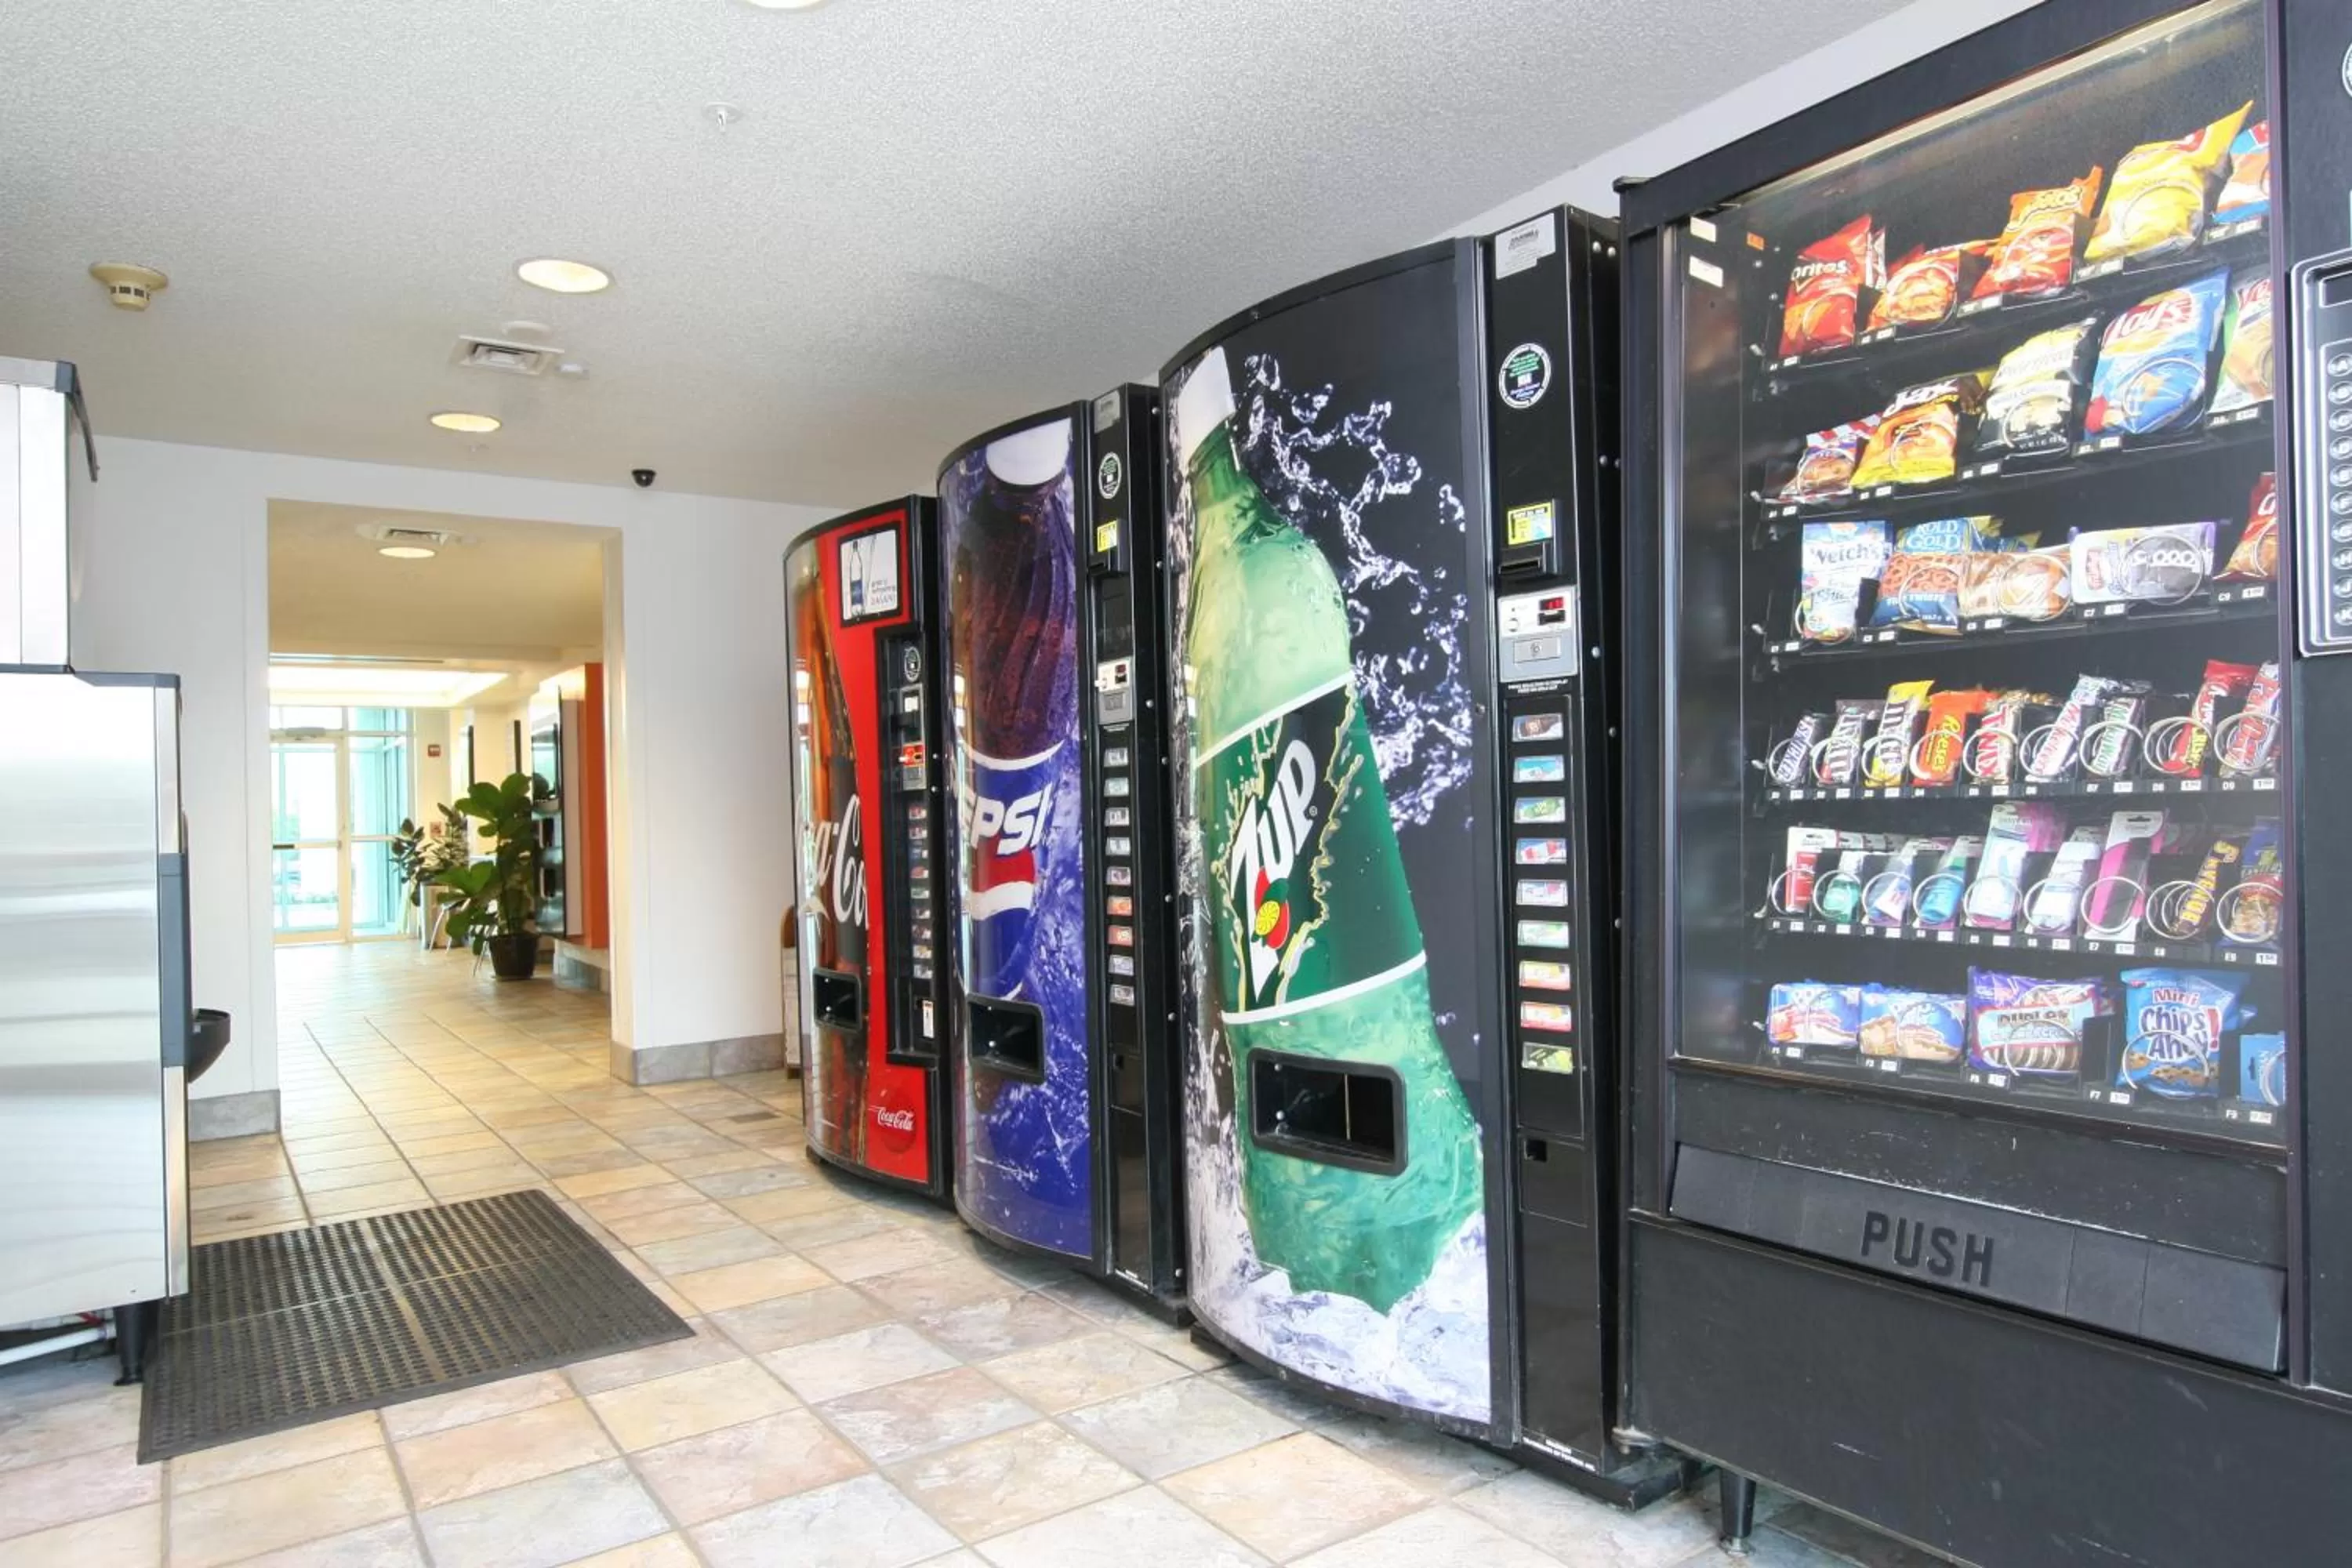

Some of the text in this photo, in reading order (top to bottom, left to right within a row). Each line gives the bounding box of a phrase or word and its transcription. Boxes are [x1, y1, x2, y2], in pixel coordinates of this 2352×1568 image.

[1791, 258, 1850, 281] oritos
[1915, 520, 1958, 534] ROLD
[1906, 534, 1960, 550] GOLD
[1775, 717, 1813, 780] SNICKER
[1230, 739, 1316, 1003] 7UP
[2153, 988, 2201, 1005] Mini
[2140, 1005, 2206, 1034] Chips
[877, 1107, 914, 1131] Coca-Cola
[1860, 1210, 1994, 1287] PUSH
